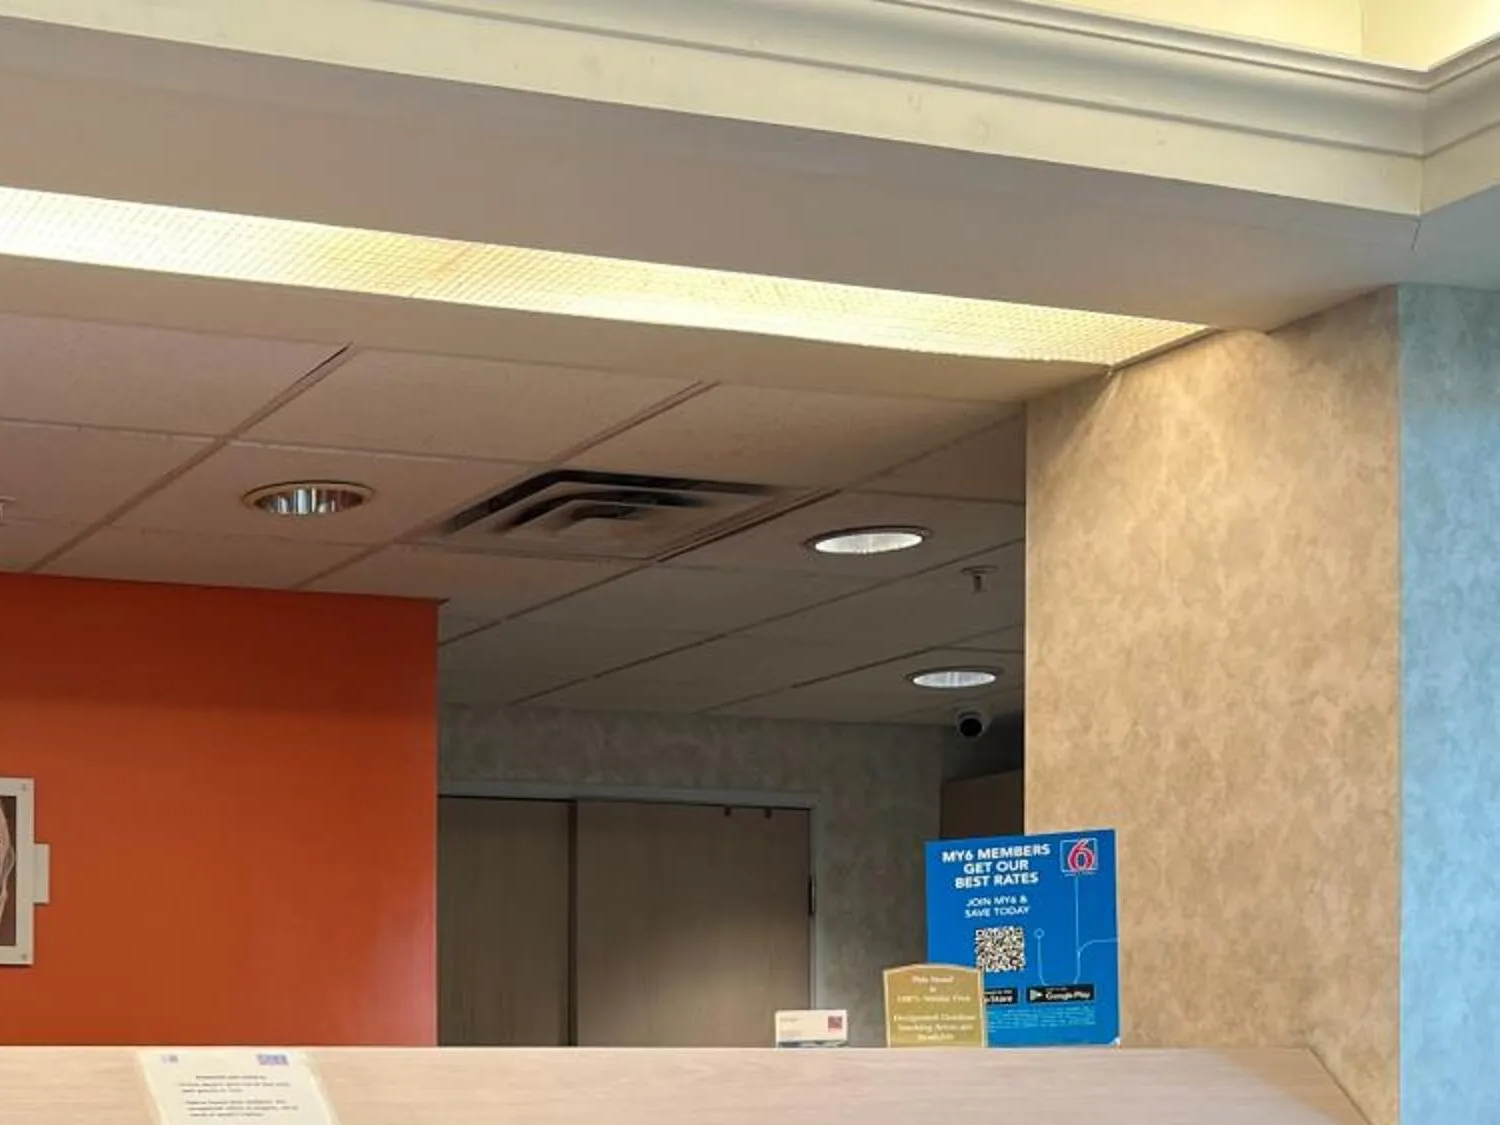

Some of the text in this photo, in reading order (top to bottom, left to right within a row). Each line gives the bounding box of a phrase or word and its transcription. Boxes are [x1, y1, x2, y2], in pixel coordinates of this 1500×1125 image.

[941, 843, 1052, 863] MY6 MEMBERS
[1068, 838, 1095, 871] 6
[963, 859, 1029, 875] GET OUR
[955, 872, 1040, 889] BEST RATES
[966, 896, 991, 907] JOIN
[965, 905, 1031, 918] SAVE TODAY
